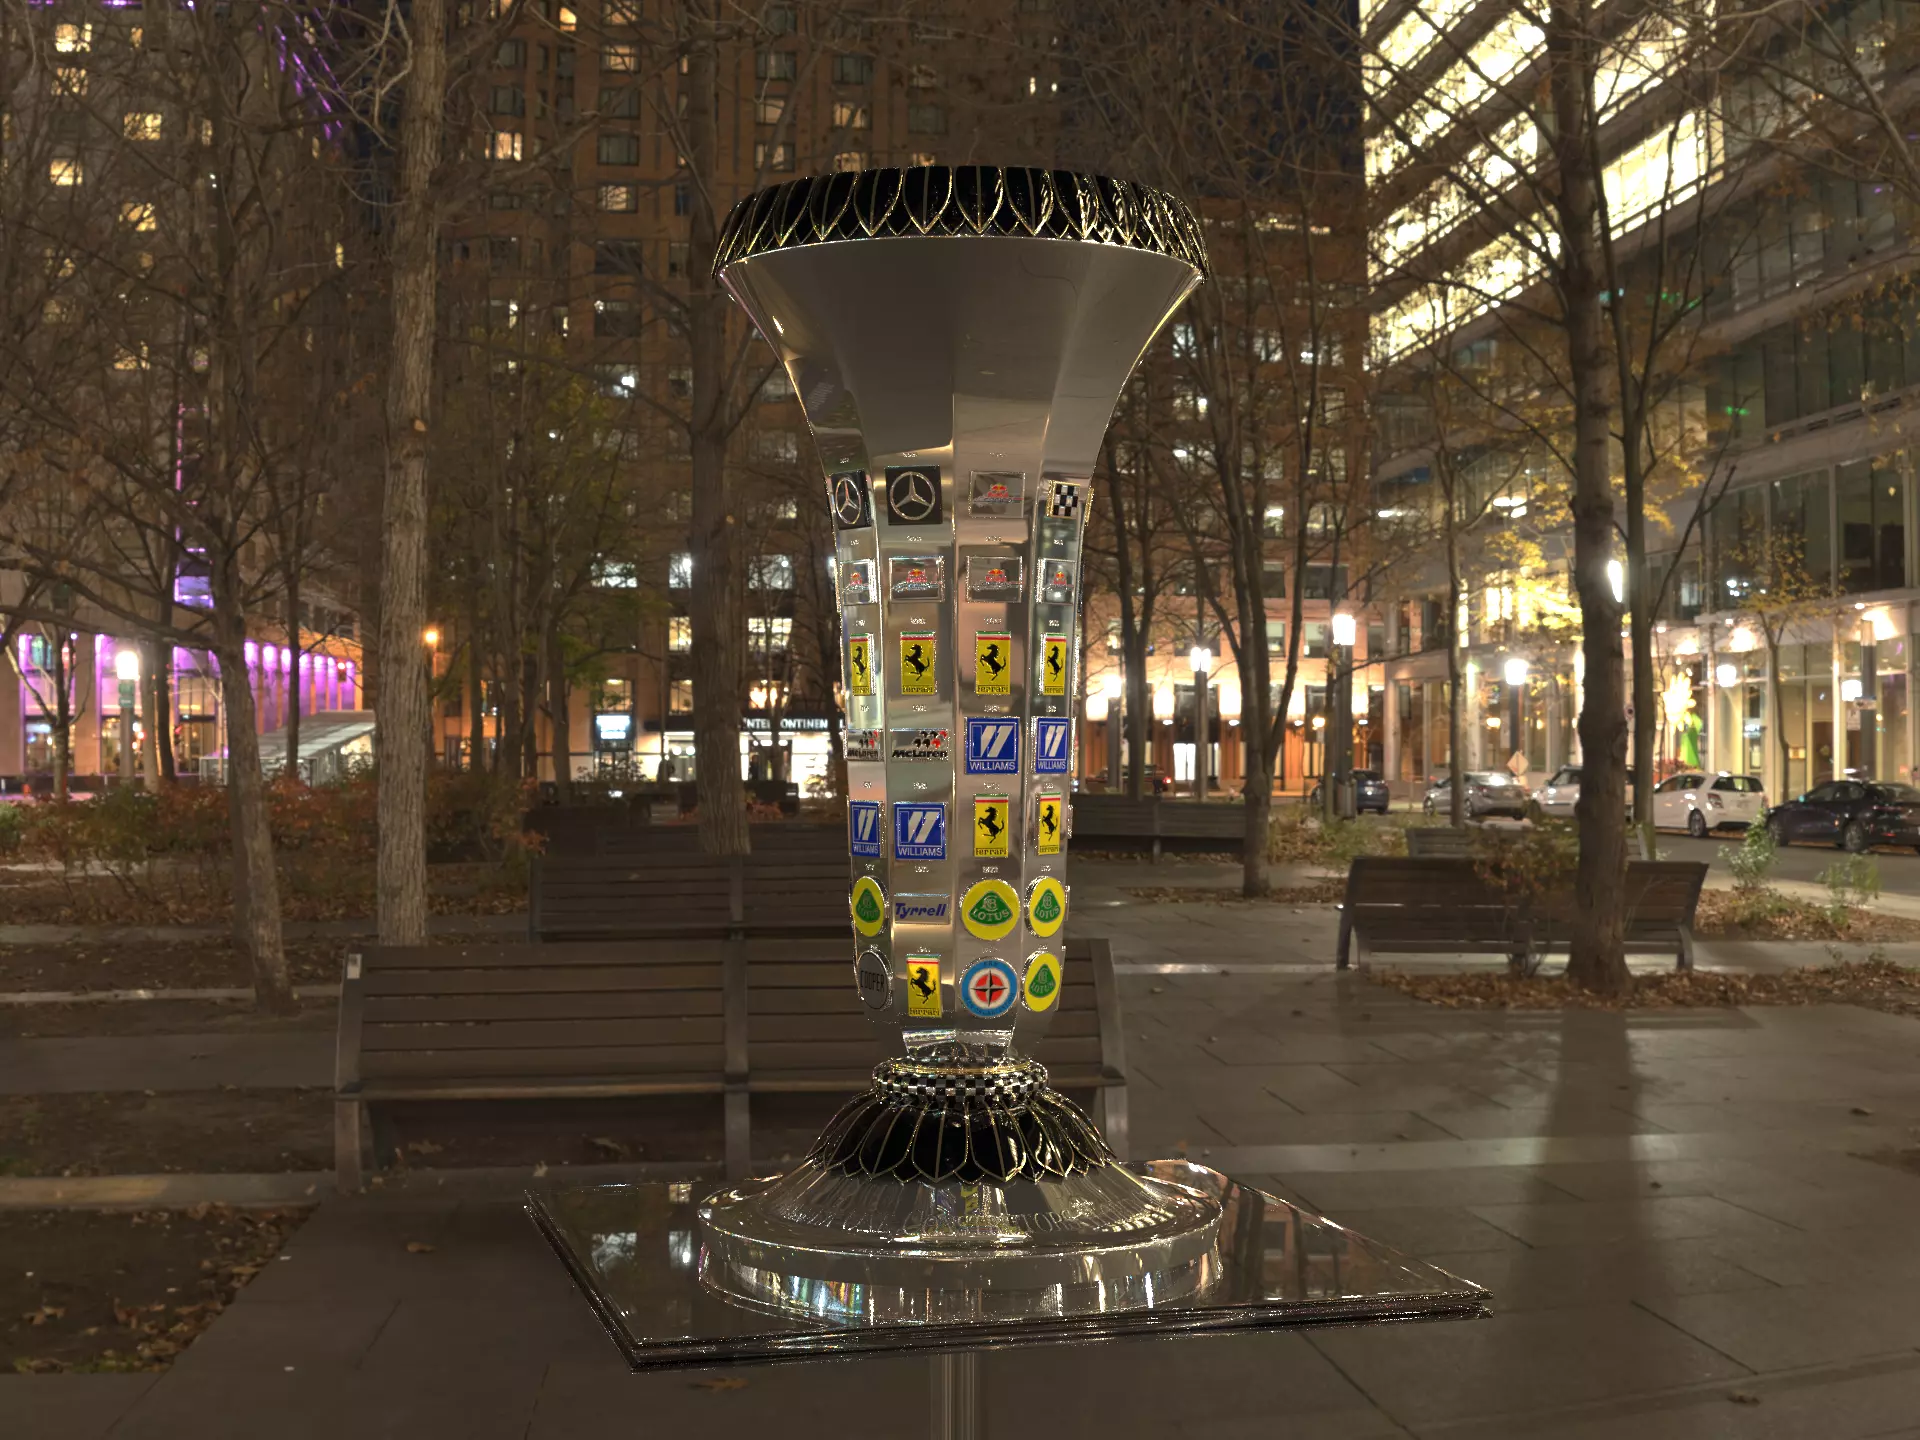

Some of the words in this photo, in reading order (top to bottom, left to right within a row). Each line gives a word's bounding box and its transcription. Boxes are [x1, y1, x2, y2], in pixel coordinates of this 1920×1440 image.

[977, 684, 1009, 692] Ferrari
[969, 762, 1015, 770] WILLIAMS
[1037, 761, 1066, 769] WILLIAMS
[852, 844, 879, 853] WILLIAMS
[898, 847, 942, 856] WILLIAMS
[895, 902, 946, 919] Tyrrell
[971, 908, 1010, 921] LOTUS
[1035, 905, 1060, 919] LOTUS
[860, 970, 884, 991] COOPER
